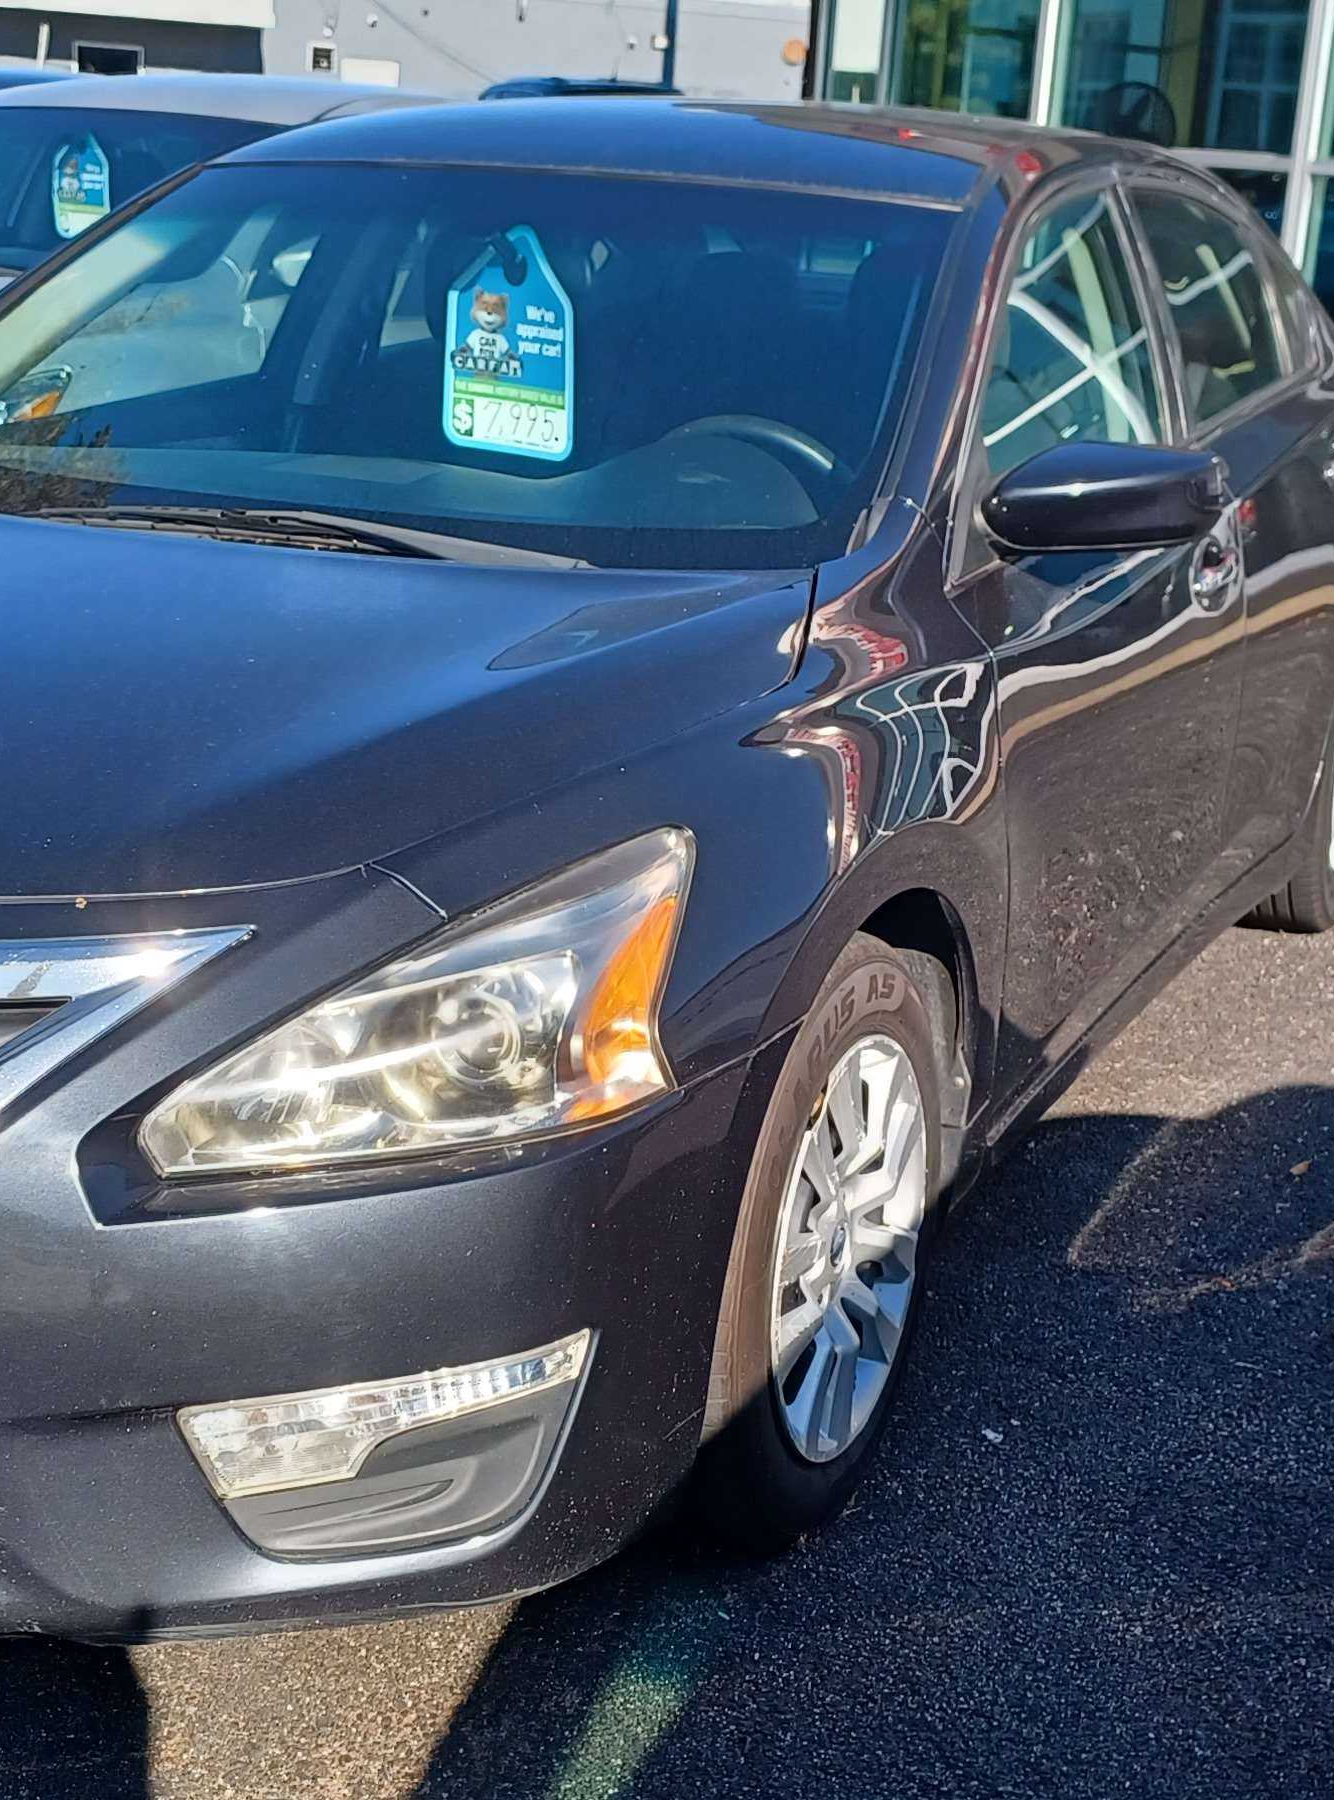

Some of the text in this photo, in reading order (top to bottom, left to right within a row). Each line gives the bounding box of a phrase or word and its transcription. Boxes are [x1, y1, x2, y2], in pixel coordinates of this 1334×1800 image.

[526, 305, 556, 323] We've
[518, 340, 541, 355] your
[865, 972, 897, 1005] AS
